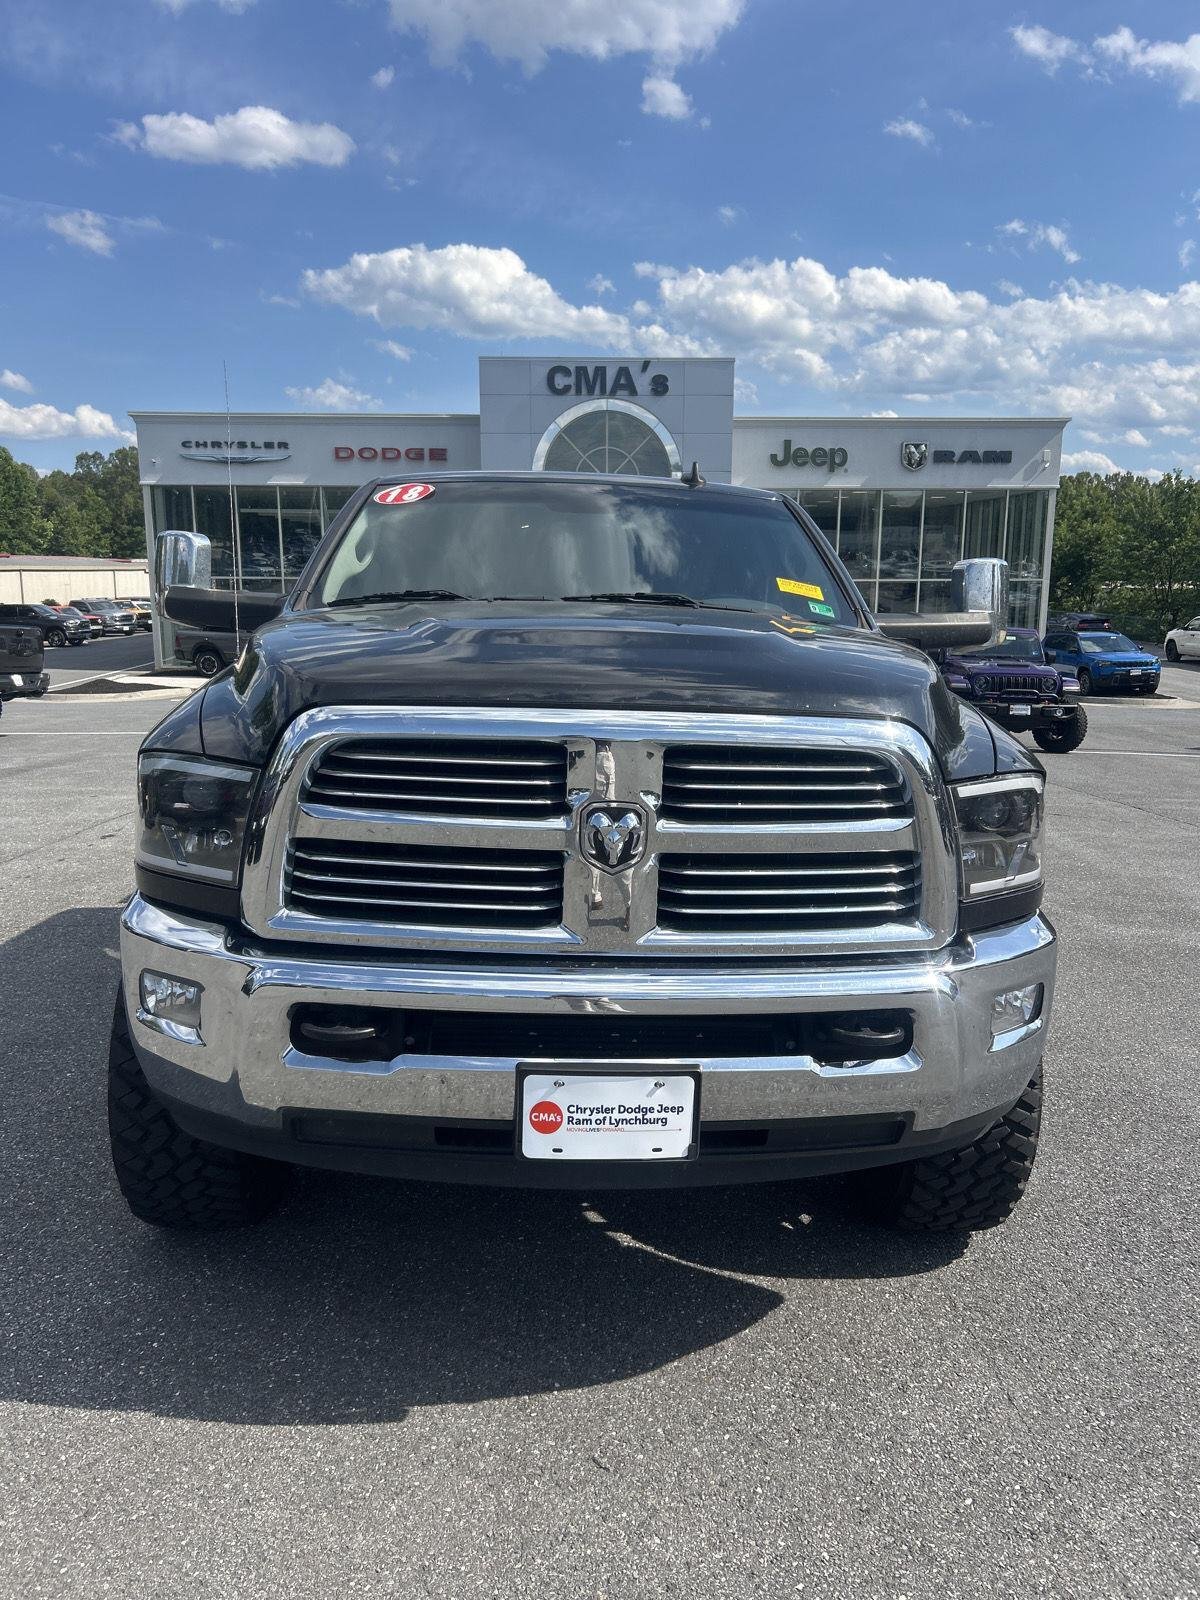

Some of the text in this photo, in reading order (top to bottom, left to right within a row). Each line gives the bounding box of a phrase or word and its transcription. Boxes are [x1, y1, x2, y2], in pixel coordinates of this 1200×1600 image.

[547, 360, 669, 397] CMA's
[181, 440, 290, 450] CHRYSLER
[334, 446, 448, 461] DODGE
[770, 439, 849, 472] Jeep
[933, 450, 1013, 464] RAM
[385, 485, 425, 502] 18
[567, 1103, 684, 1116] Chrysler Dodge Jeep
[531, 1112, 562, 1122] CMA's
[567, 1115, 668, 1127] Ram of Lynchburg
